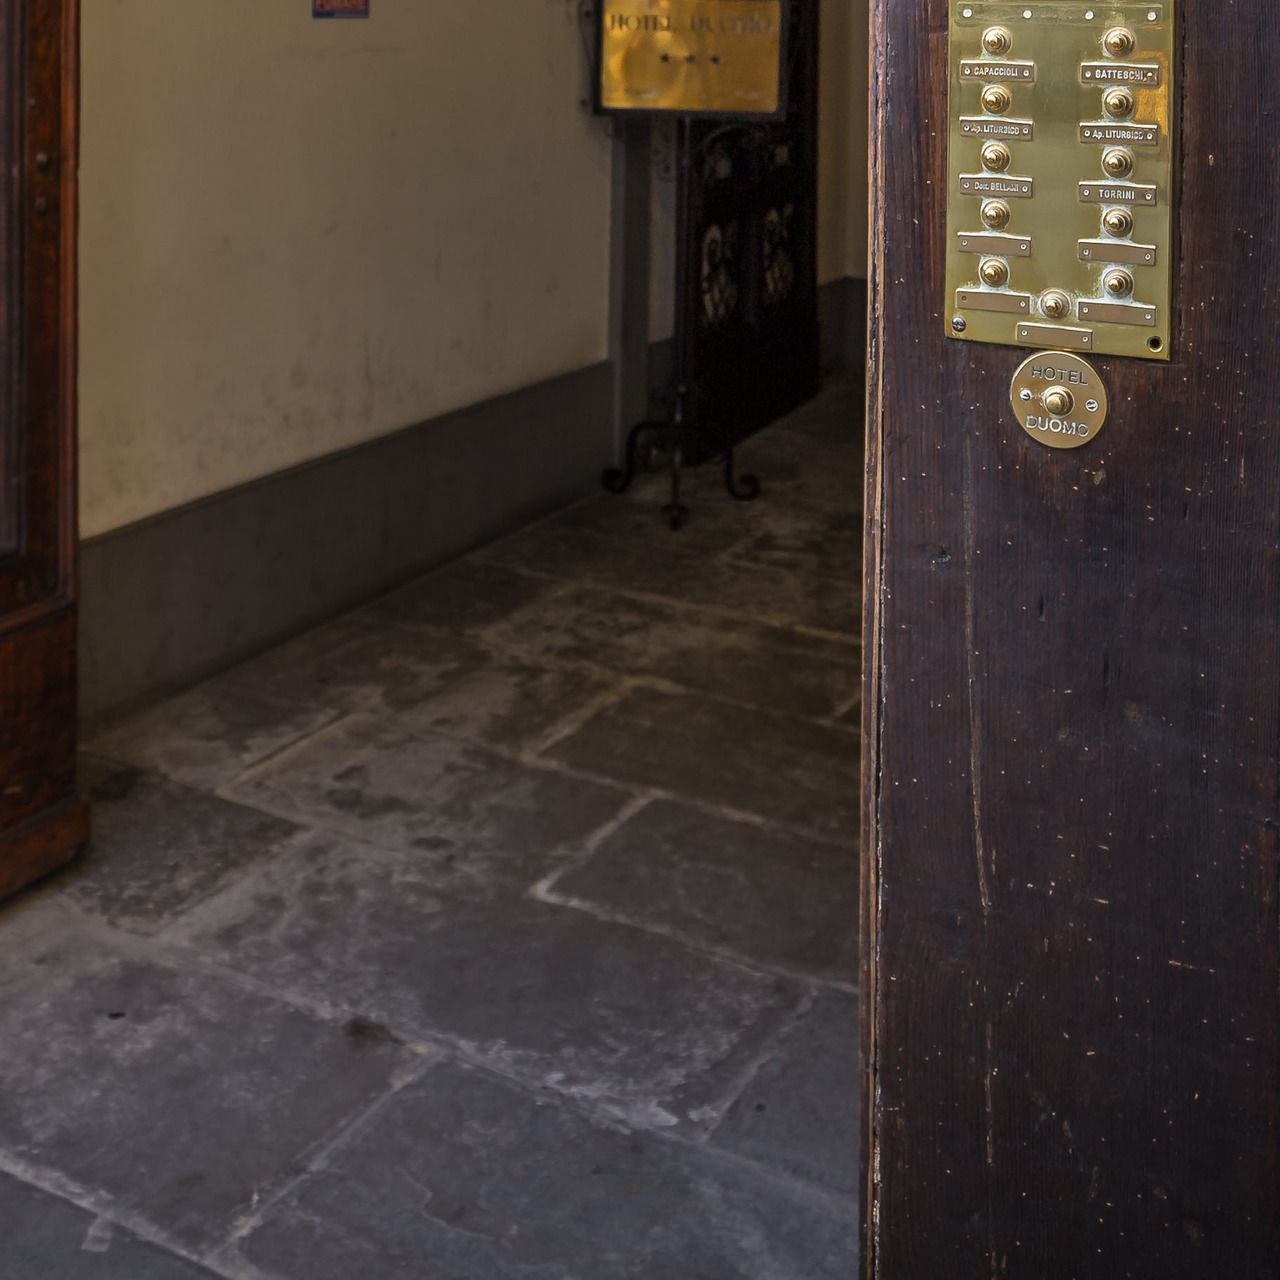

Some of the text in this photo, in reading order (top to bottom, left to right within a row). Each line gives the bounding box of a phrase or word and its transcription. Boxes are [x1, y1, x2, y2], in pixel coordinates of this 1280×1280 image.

[609, 14, 673, 32] HOTEL
[974, 66, 1018, 77] CAPACCIOLI
[1098, 189, 1135, 200] TORRINI
[1031, 365, 1089, 386] HOTEL
[1025, 415, 1089, 438] DUOMO
